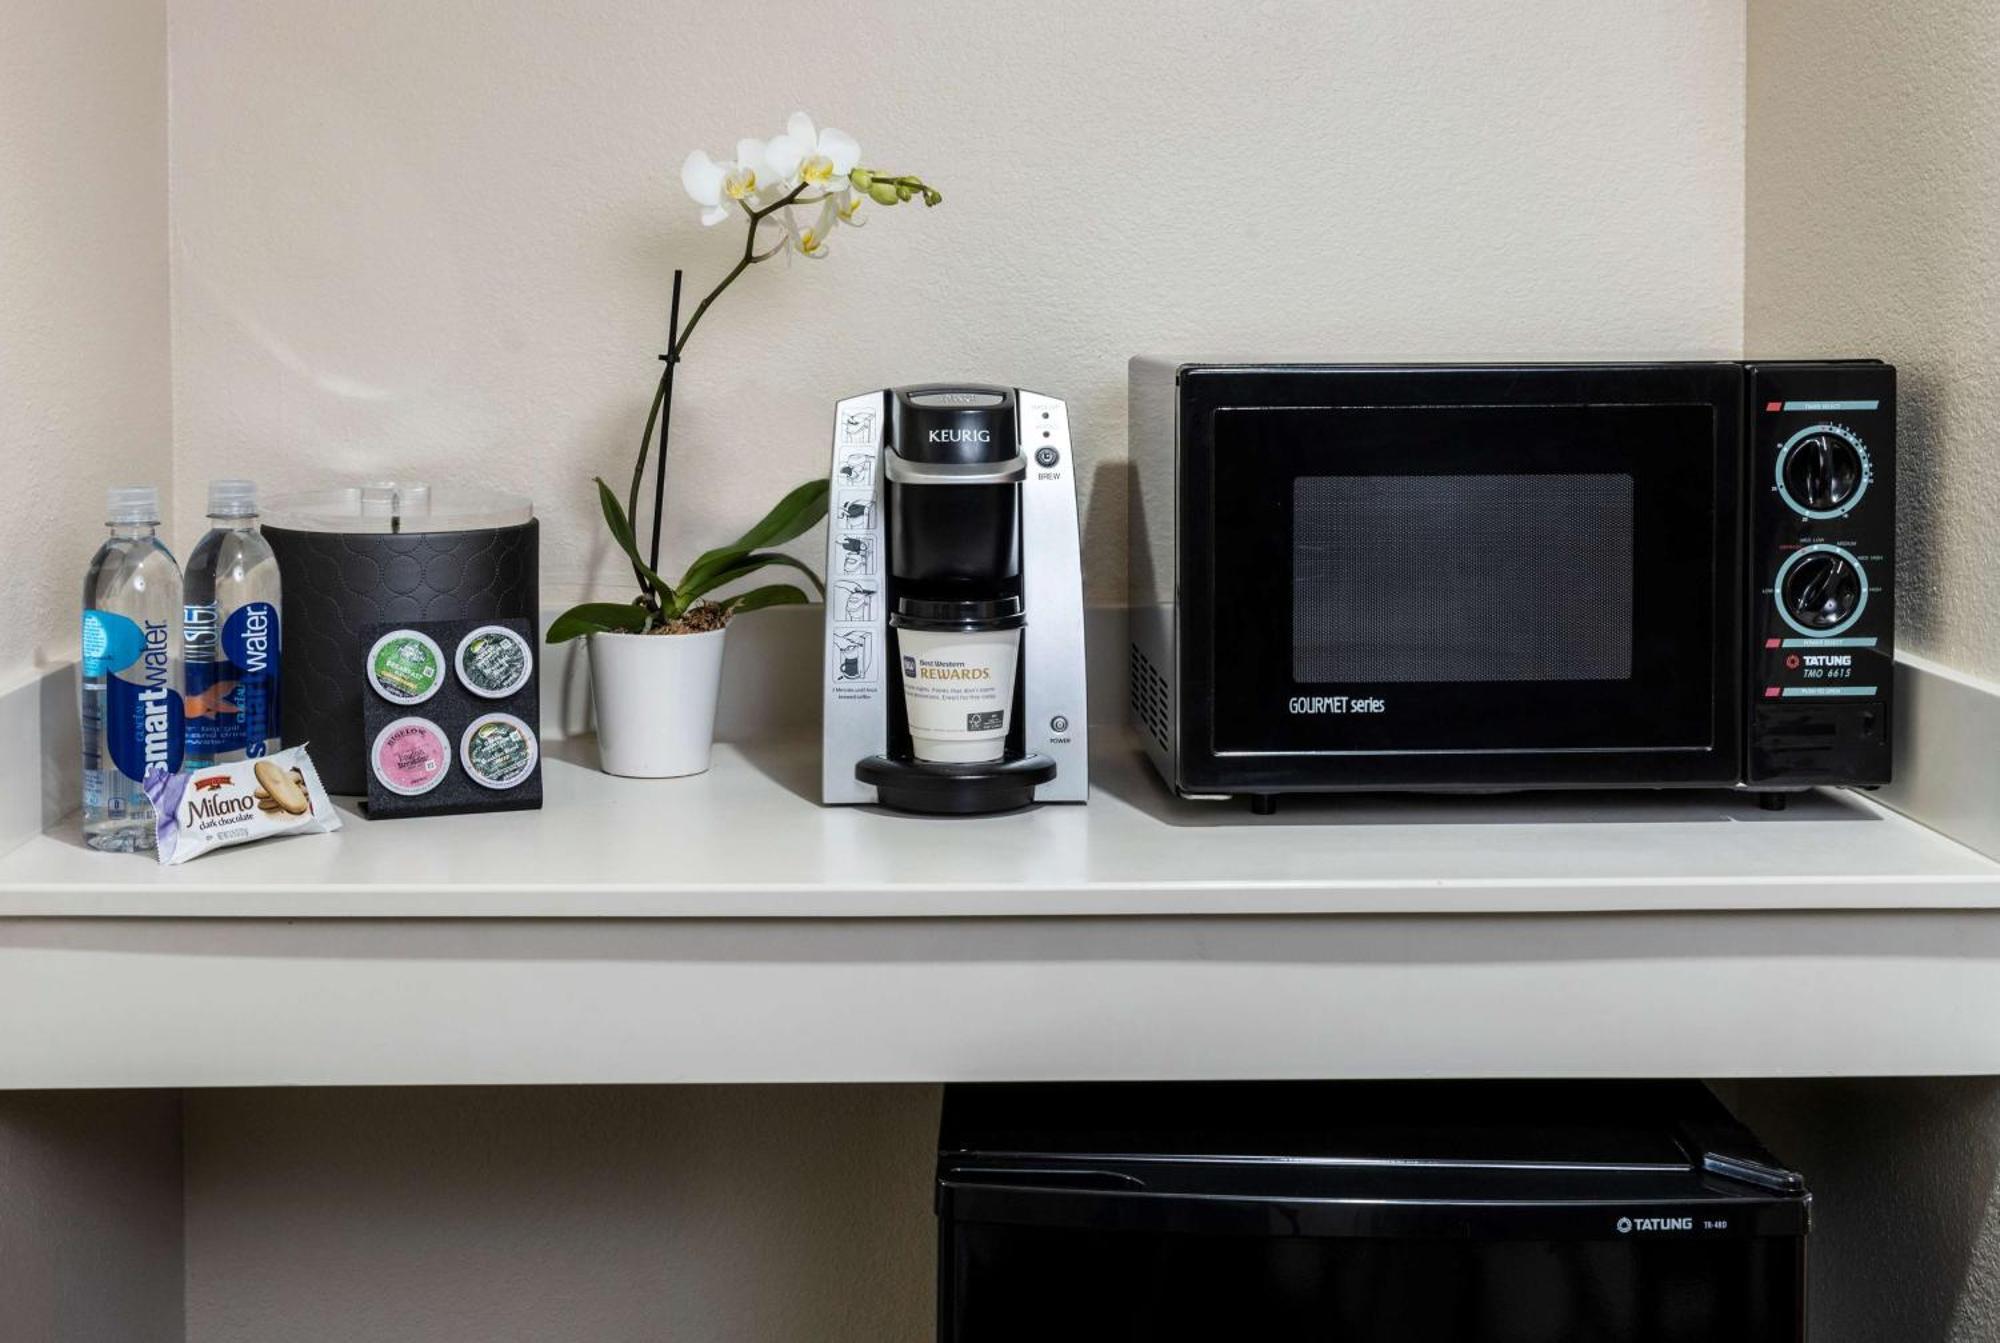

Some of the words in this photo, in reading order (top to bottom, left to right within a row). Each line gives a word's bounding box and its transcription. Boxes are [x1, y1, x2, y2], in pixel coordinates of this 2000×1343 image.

[928, 429, 991, 443] KEURIG
[1038, 472, 1061, 481] BREW
[919, 659, 934, 667] Best
[934, 660, 965, 668] Western
[1802, 655, 1852, 666] TATUNG
[919, 668, 991, 680] REWARDS
[1803, 668, 1823, 678] TMO
[1827, 668, 1852, 678] 6615
[1288, 696, 1349, 714] GOURMET
[1350, 696, 1385, 713] series
[387, 728, 427, 747] BIGELOW
[186, 793, 254, 828] Milano
[199, 818, 218, 831] dark
[217, 813, 254, 827] chocolate
[1633, 1217, 1693, 1231] TATUNG
